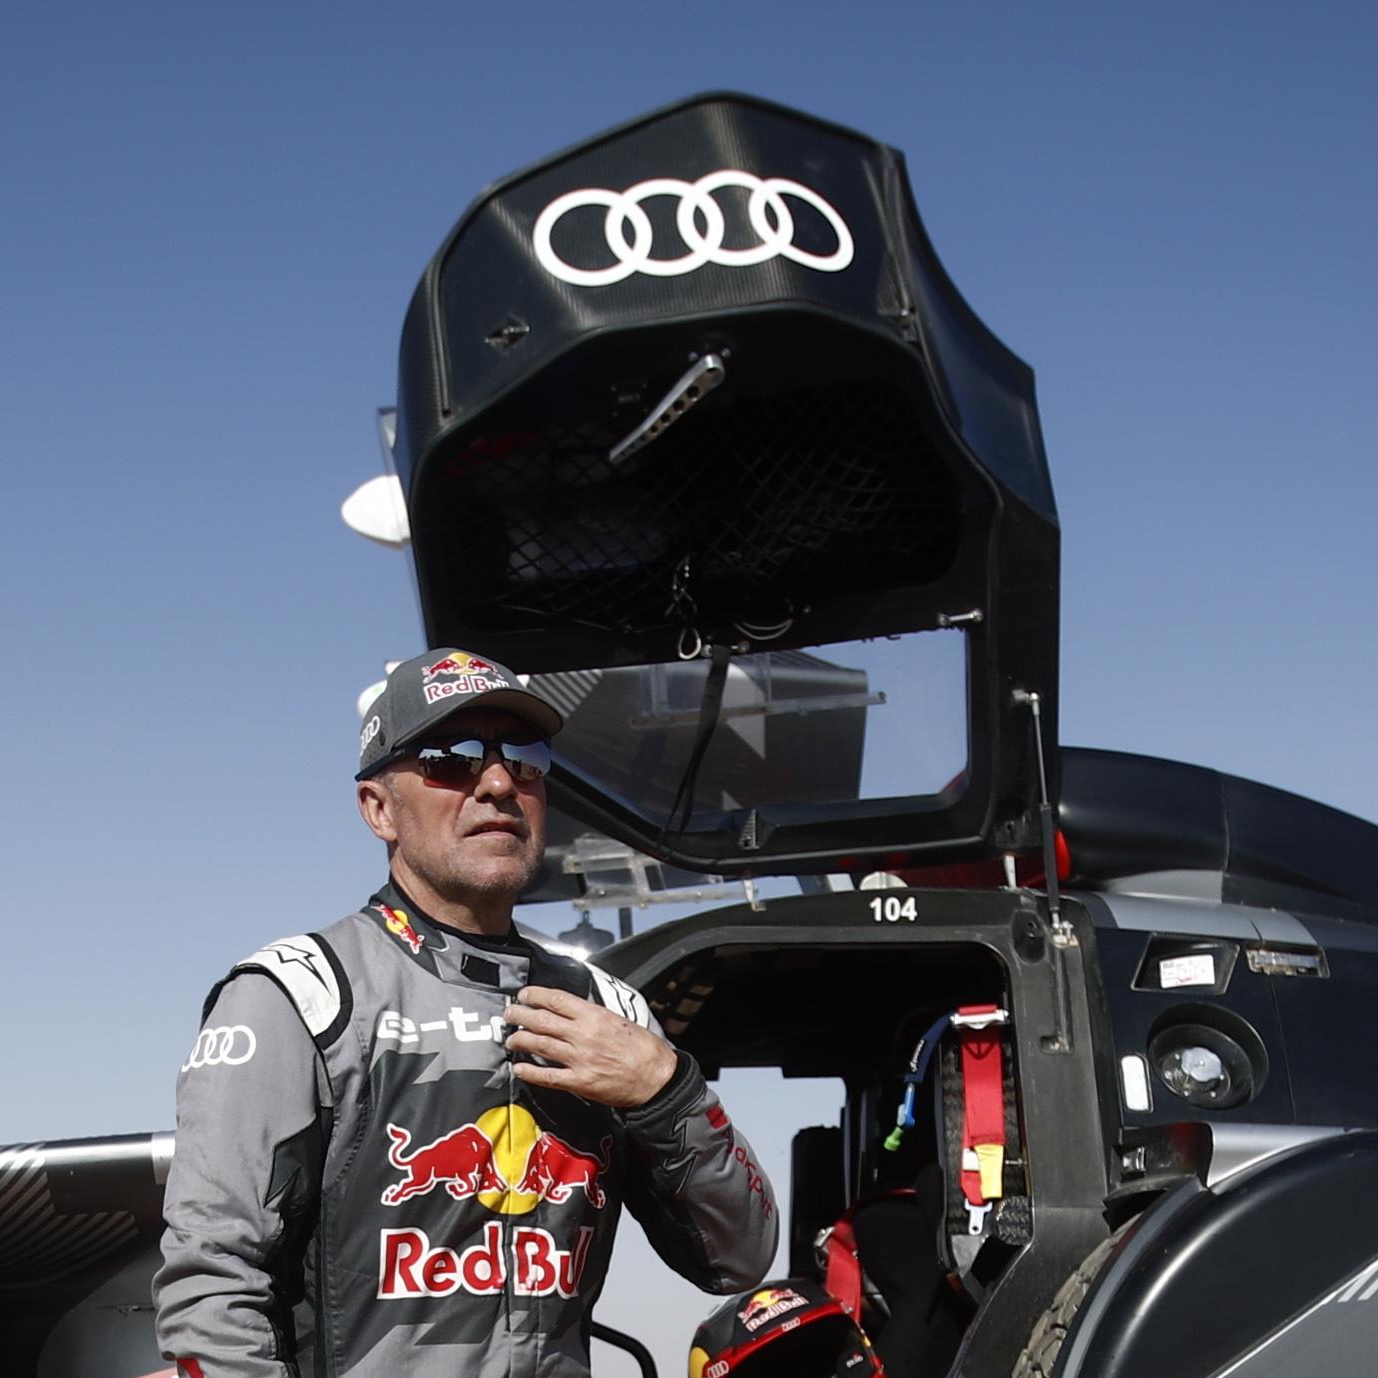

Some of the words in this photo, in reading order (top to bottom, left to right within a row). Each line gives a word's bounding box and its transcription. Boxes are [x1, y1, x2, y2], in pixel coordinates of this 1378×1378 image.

[424, 674, 472, 704] Red
[869, 896, 918, 922] 104
[377, 1220, 507, 1300] Red
